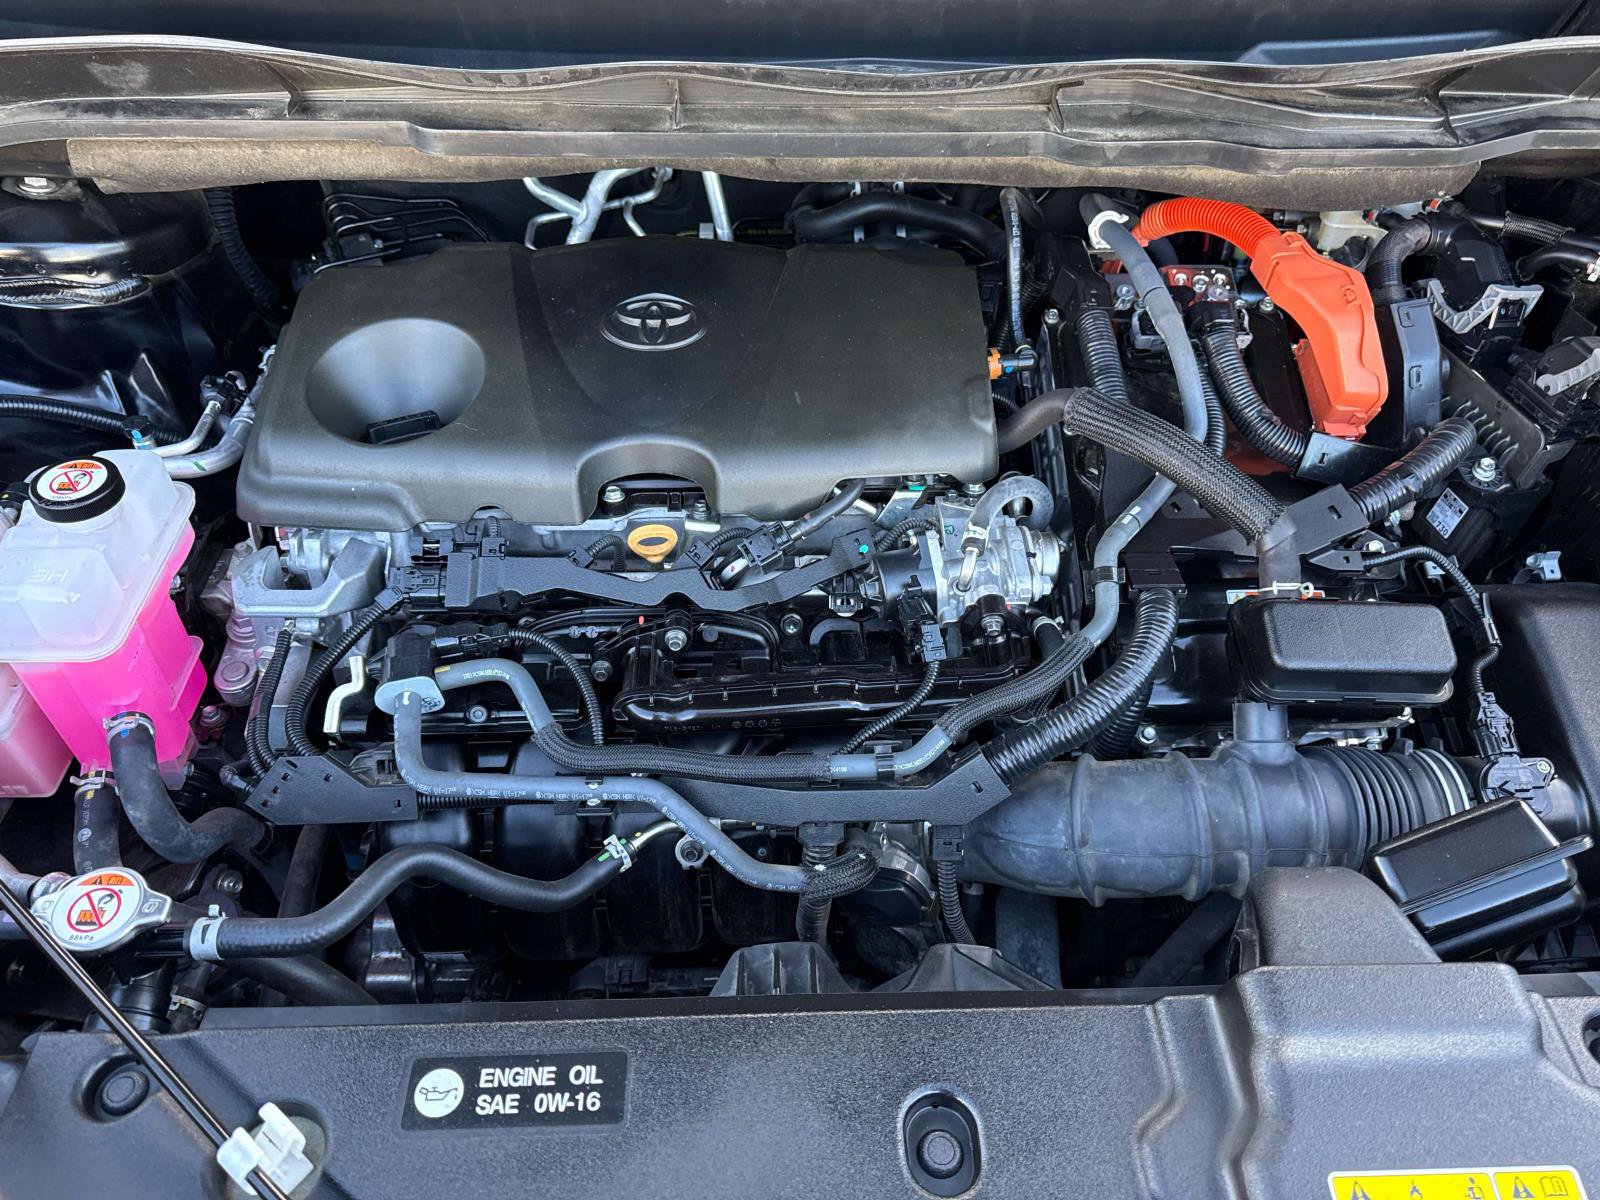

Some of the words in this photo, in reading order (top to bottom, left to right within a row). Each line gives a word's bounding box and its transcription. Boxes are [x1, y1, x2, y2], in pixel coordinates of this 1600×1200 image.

[478, 1066, 557, 1088] ENGINE
[568, 1065, 604, 1085] OIL
[475, 1094, 521, 1116] SAE
[533, 1092, 601, 1114] 0W-16
